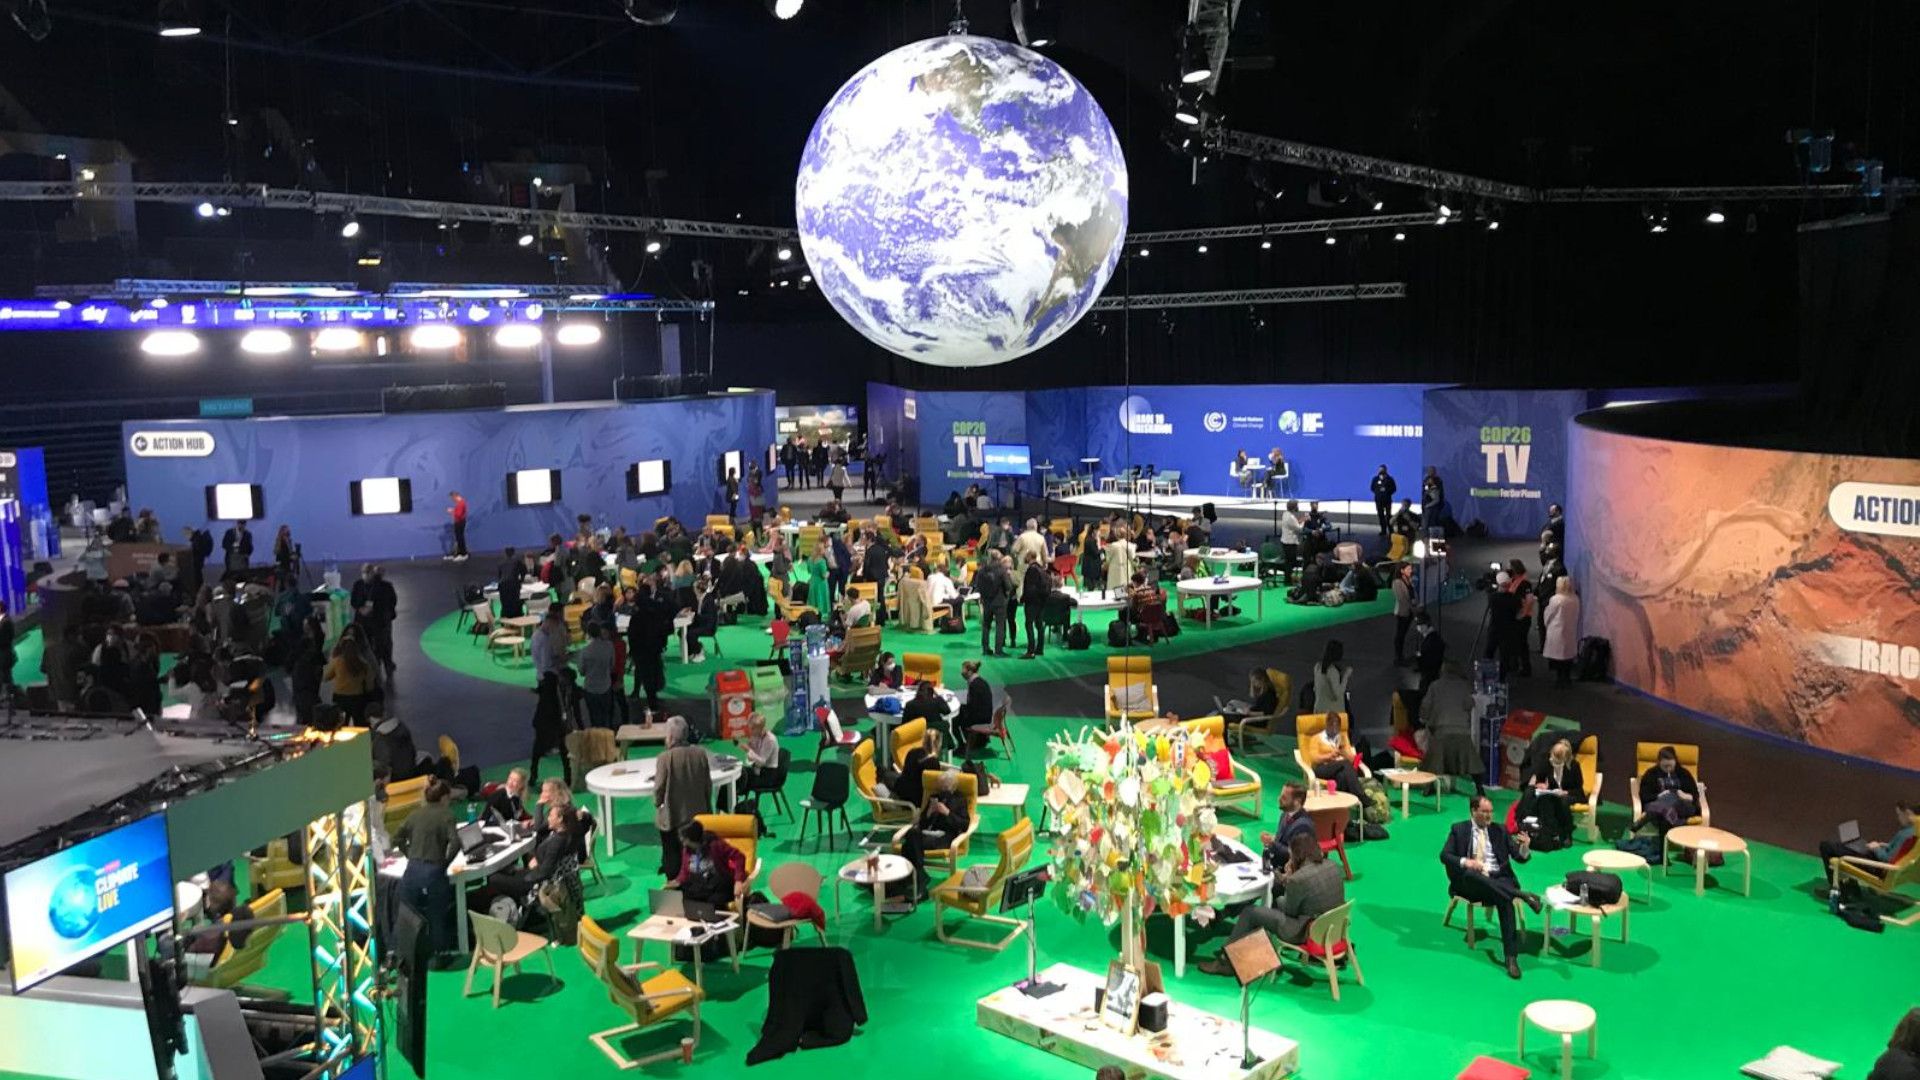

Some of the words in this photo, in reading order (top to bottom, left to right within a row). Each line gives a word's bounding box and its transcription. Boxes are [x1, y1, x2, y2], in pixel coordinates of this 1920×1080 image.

[952, 421, 987, 435] COP26
[1404, 425, 1414, 437] TO
[1480, 426, 1532, 443] COP26
[153, 437, 184, 450] ACTION
[186, 437, 205, 450] HUB
[953, 435, 986, 467] TV
[1481, 444, 1531, 484] TV
[95, 861, 139, 896] CLIMATE
[97, 888, 120, 913] LIVE
